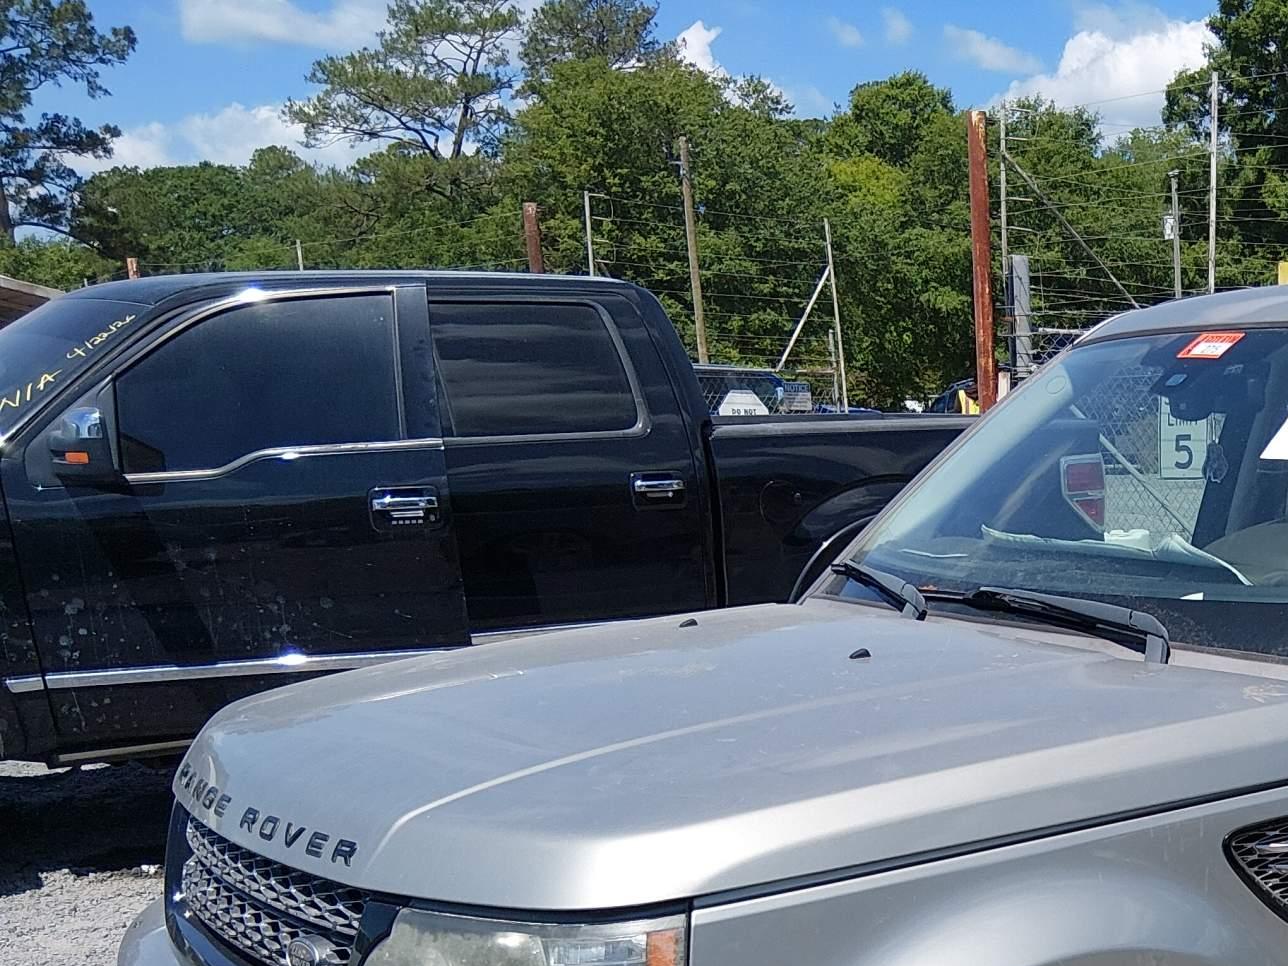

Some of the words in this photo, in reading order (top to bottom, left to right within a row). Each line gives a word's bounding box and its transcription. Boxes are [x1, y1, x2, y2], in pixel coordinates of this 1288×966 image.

[784, 384, 809, 393] NOTICE
[731, 408, 742, 416] DO
[743, 408, 757, 416] NOT
[1174, 434, 1194, 470] 5
[179, 762, 233, 818] RANGE
[239, 806, 359, 868] ROVER
